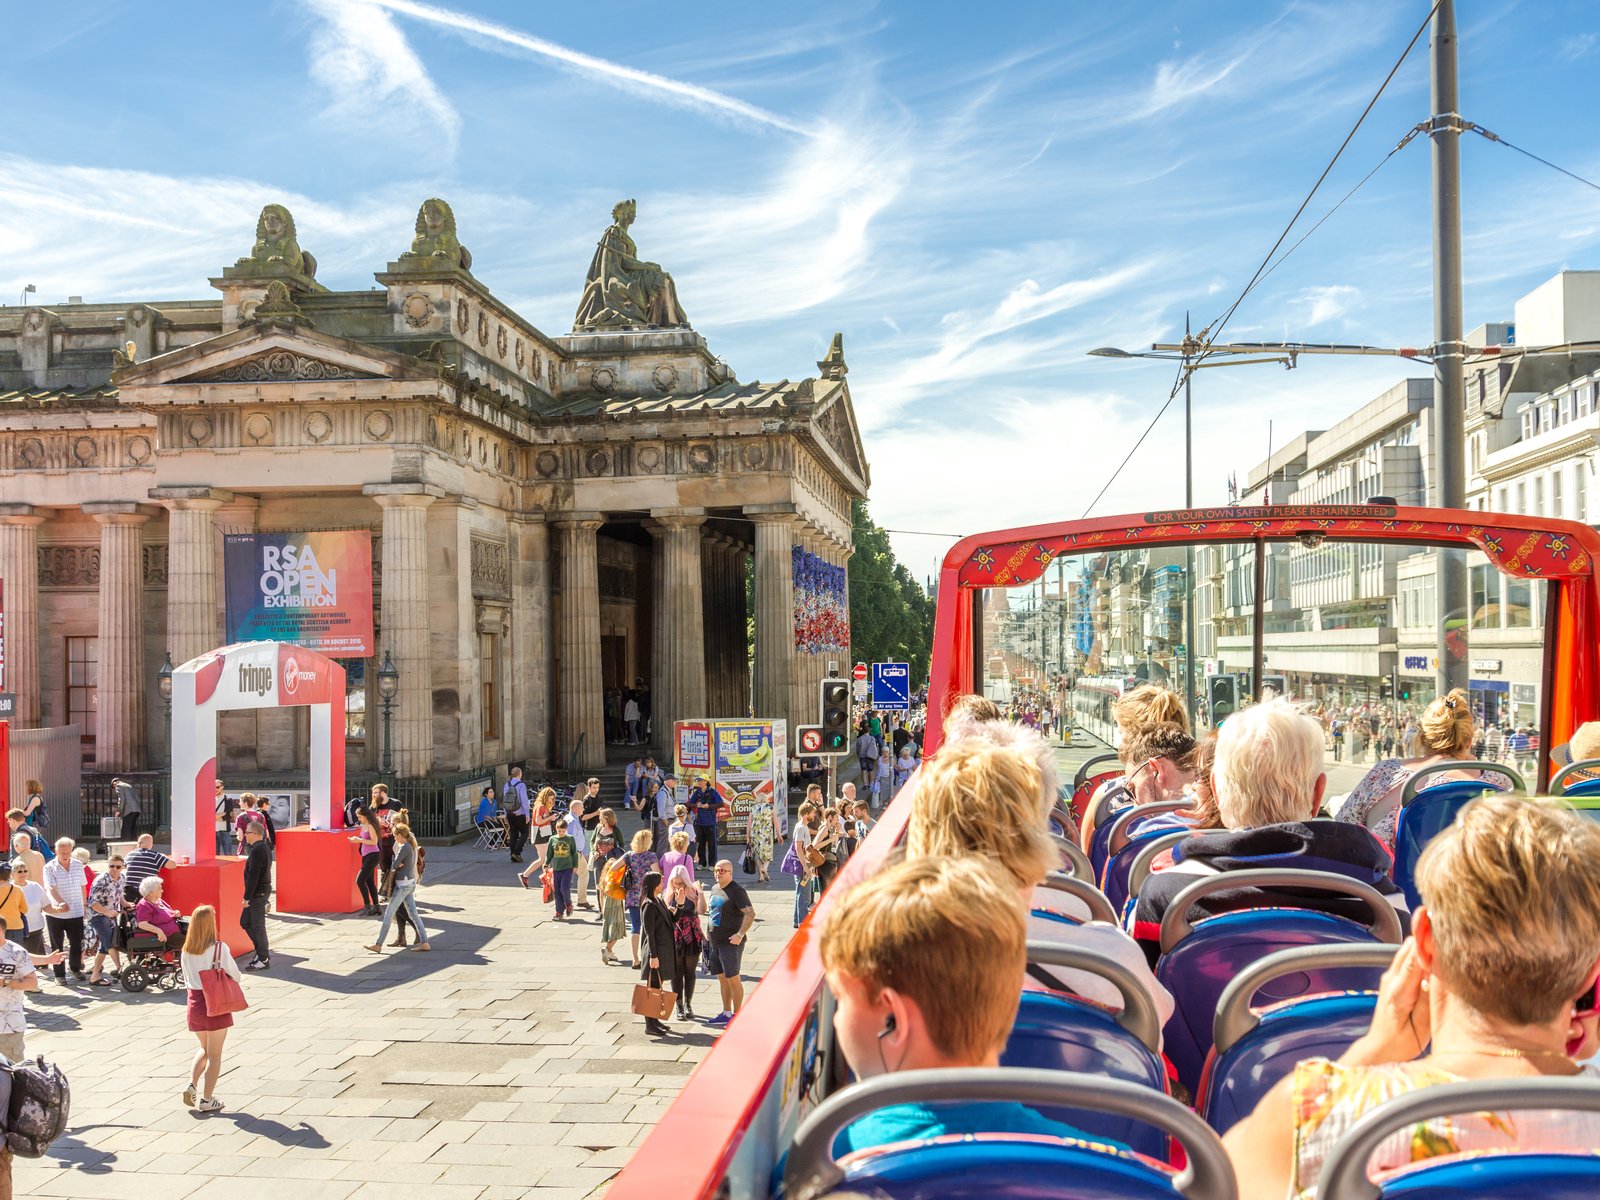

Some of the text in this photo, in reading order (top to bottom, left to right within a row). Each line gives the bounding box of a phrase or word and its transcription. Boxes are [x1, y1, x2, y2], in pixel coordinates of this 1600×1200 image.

[1153, 507, 1388, 522] FOR YOUR OWN SAFETY PLEASE REMAIN SEATED
[263, 544, 319, 571] RSA
[1505, 555, 1520, 571] ity
[260, 568, 336, 596] OPEN
[263, 594, 337, 608] EXHIBITION
[238, 662, 272, 697] fringe
[298, 671, 317, 683] money
[720, 730, 738, 744] BIG
